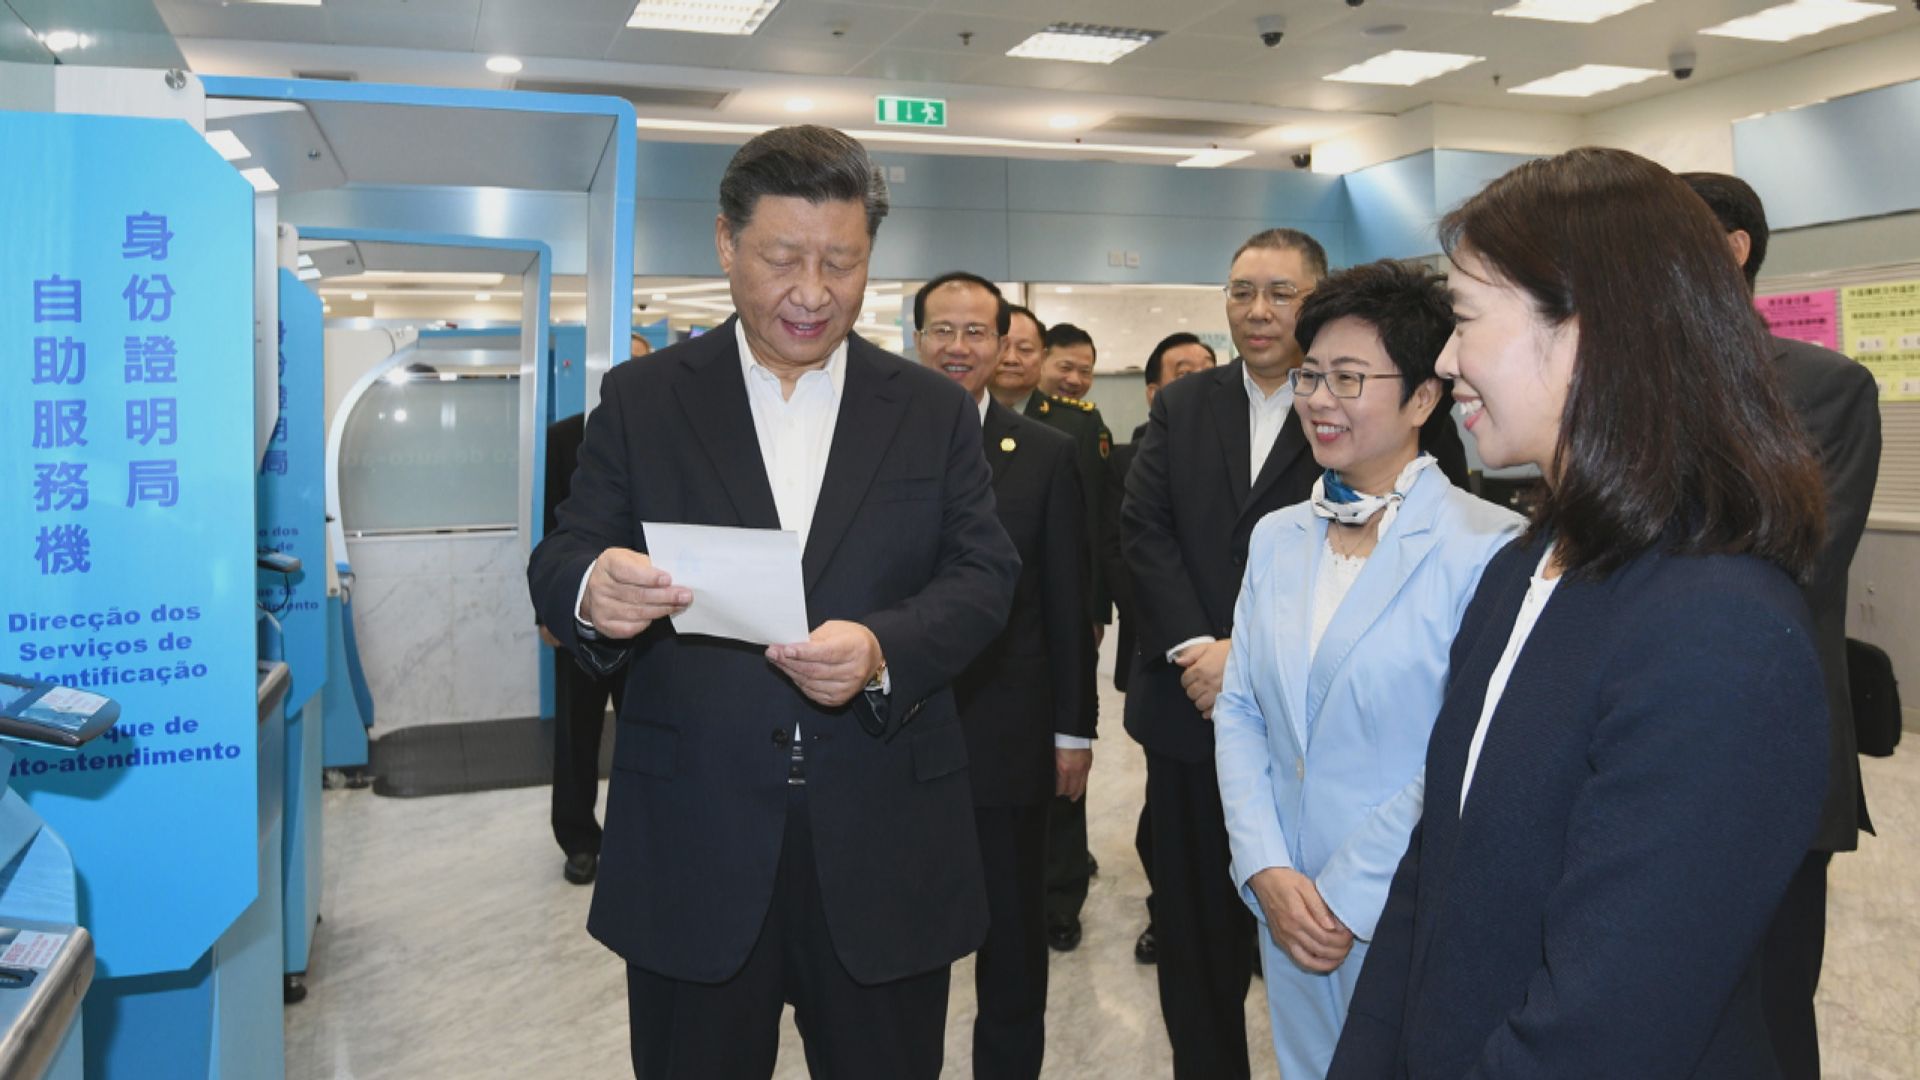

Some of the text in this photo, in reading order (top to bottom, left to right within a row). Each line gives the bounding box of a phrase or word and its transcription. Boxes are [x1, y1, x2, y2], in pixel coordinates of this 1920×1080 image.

[121, 210, 180, 509] 身份證明局
[31, 273, 91, 576] 自助服務機
[8, 604, 201, 632] Direcção dos
[19, 632, 193, 661] Serviços de
[34, 660, 208, 687] entificação
[165, 716, 199, 735] de
[10, 742, 241, 777] to-atendimento
